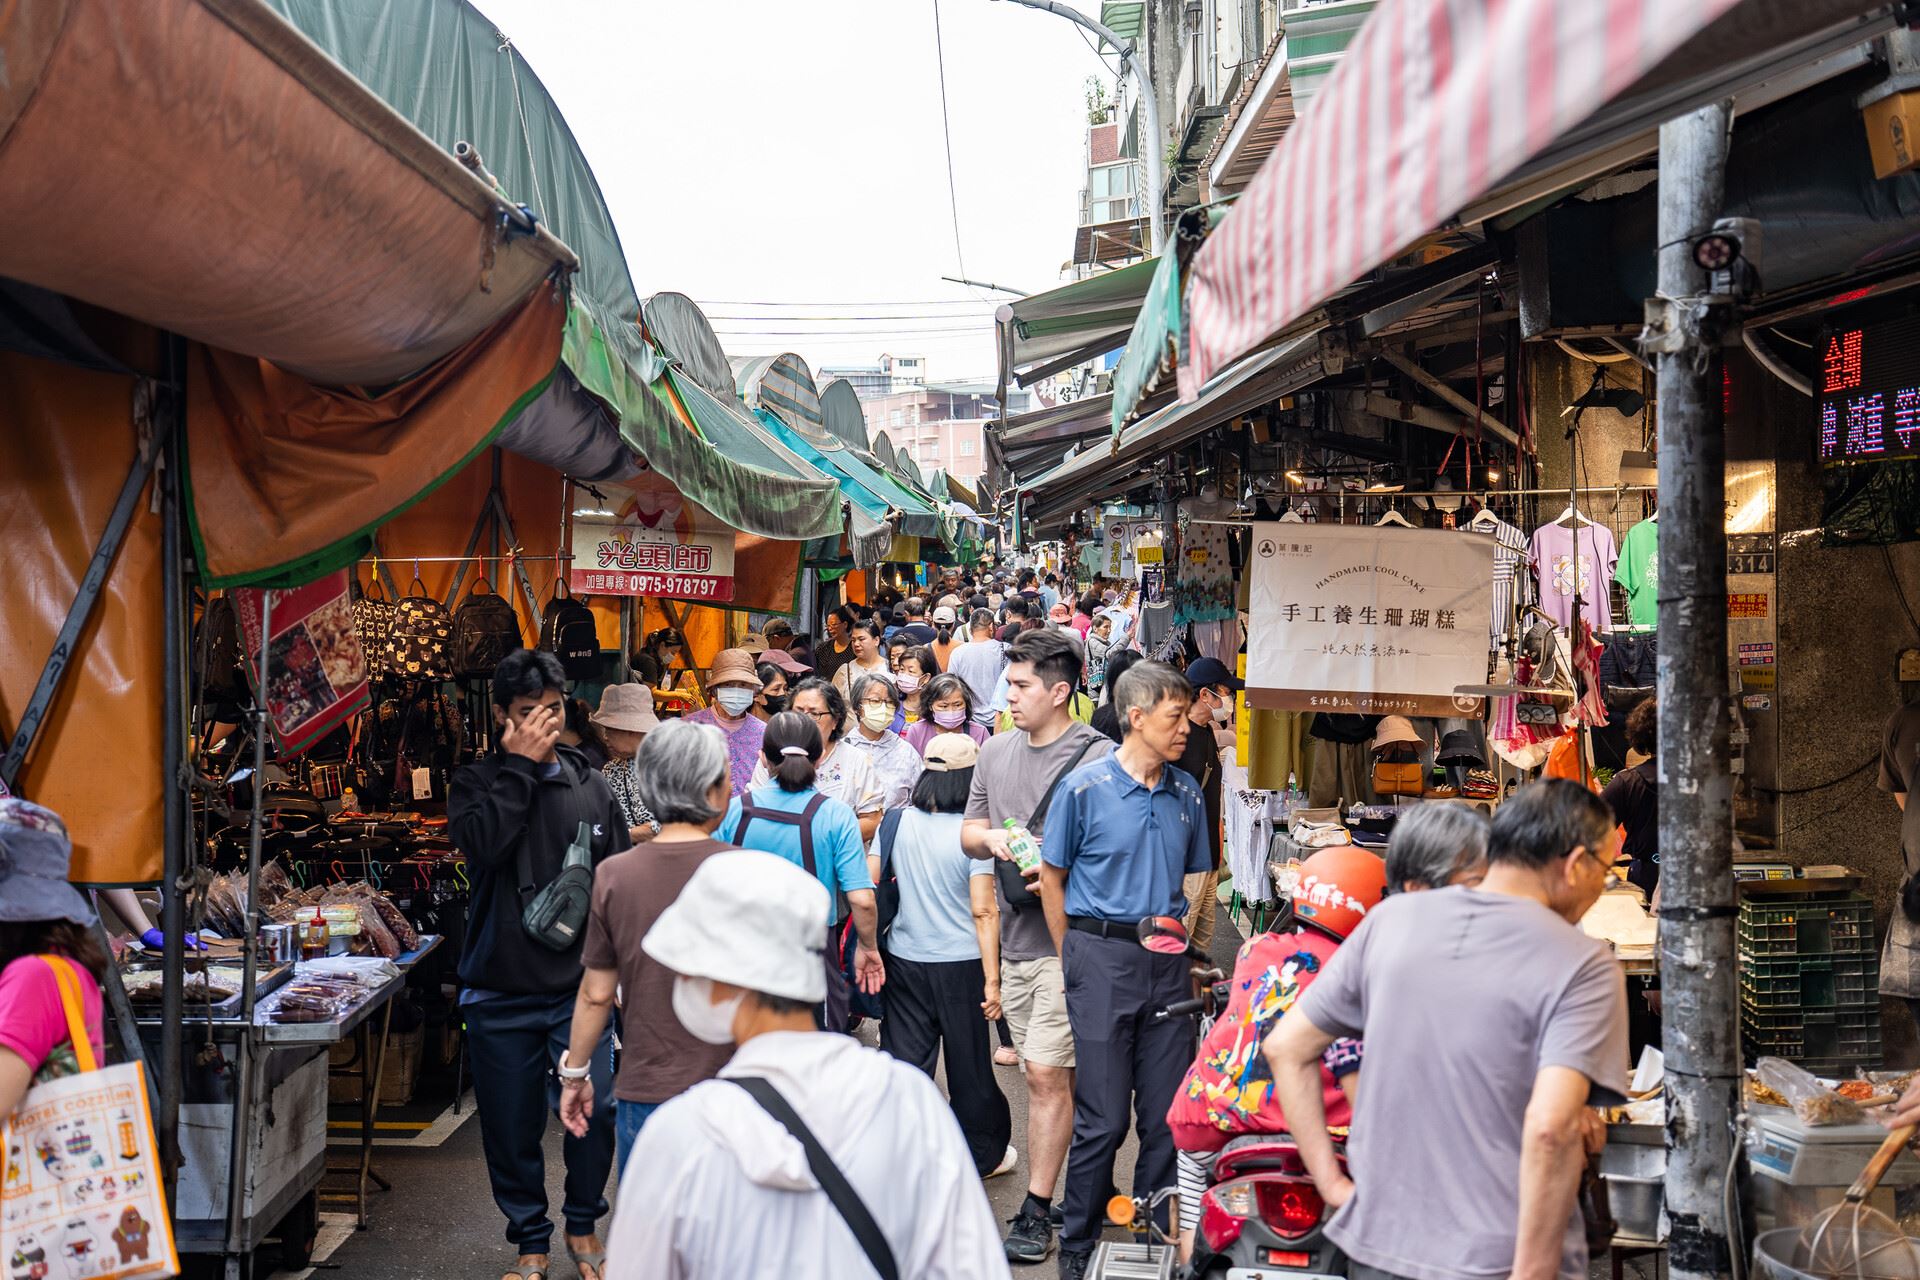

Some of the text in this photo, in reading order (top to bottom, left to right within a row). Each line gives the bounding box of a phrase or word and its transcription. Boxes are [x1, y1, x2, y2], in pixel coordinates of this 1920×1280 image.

[597, 540, 712, 573] 光頭師
[586, 575, 718, 596] 加盟專線: 0975-978797
[1315, 565, 1425, 594] HANDMADE COOL CAKE
[1281, 603, 1456, 629] 手工養生珊瑚糕
